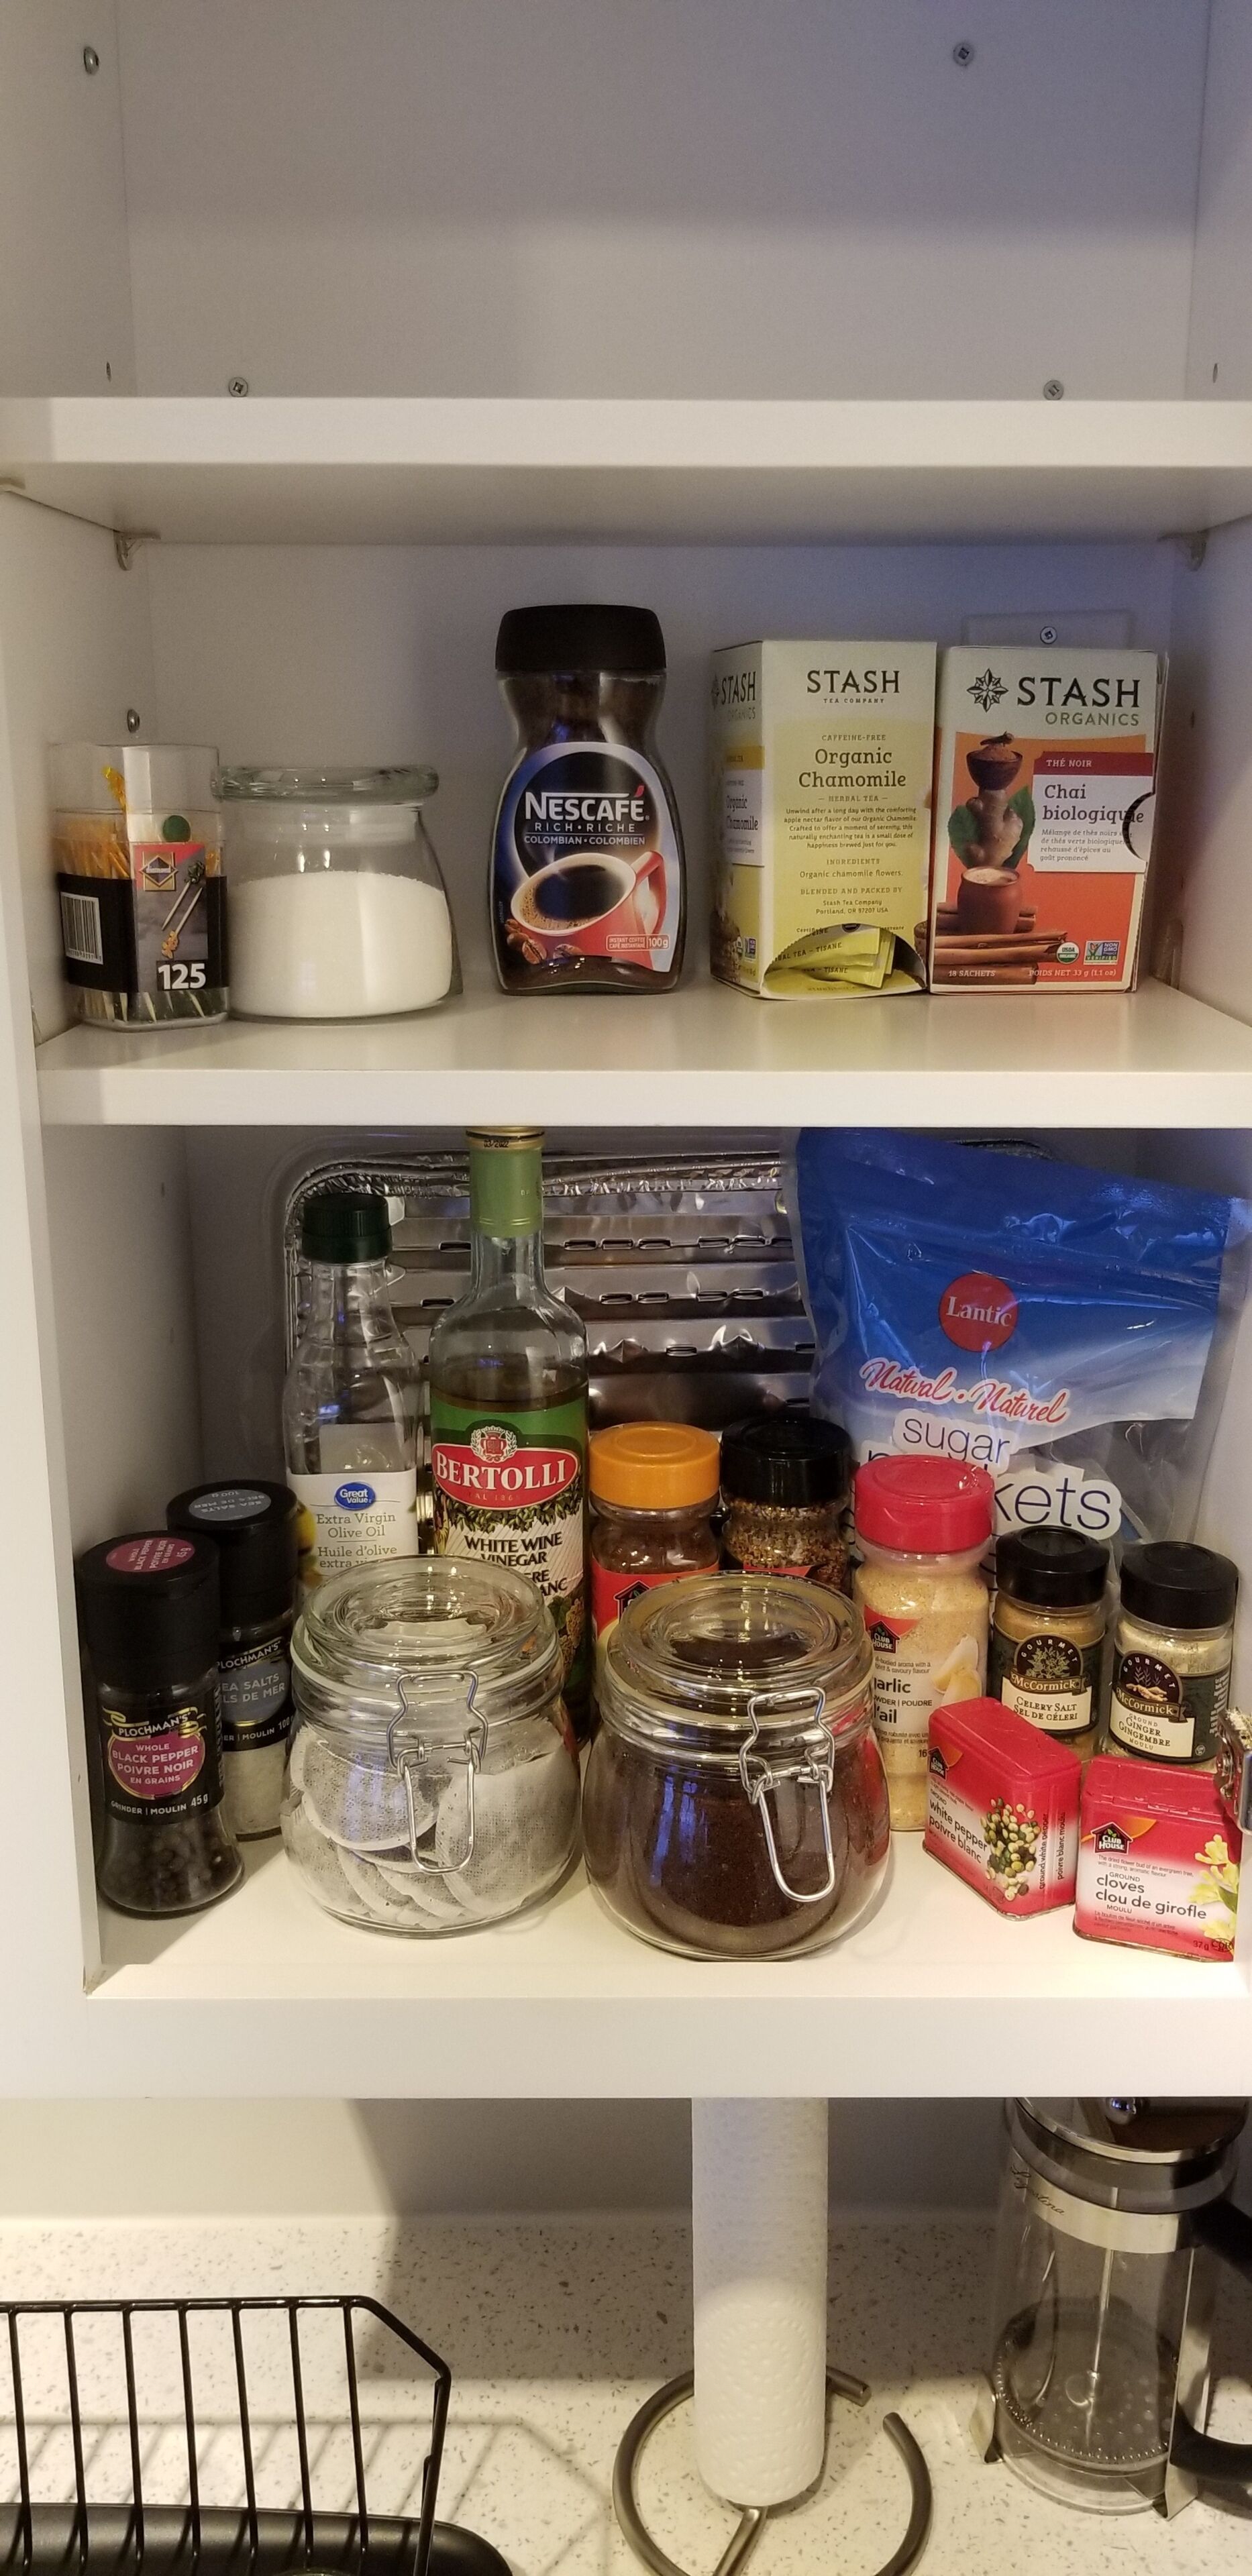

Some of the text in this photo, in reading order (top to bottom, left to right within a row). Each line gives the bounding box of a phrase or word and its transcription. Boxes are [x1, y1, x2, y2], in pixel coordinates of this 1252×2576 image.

[721, 671, 756, 704] STASH
[807, 669, 900, 694] STASH
[1017, 677, 1140, 727] STASH ORGANICS
[815, 747, 892, 768] Organic
[1046, 758, 1092, 767] THÉ NOIR
[798, 771, 906, 788] Chamomile
[1045, 784, 1086, 799] Chai
[525, 786, 645, 821] NESCAFÉ
[1043, 806, 1144, 824] biologique
[535, 822, 635, 832] RICH RICHE
[525, 836, 645, 845] COLOMBIAN COLOMBIEN
[800, 871, 829, 879] Organic
[816, 942, 842, 953] TISANE
[158, 963, 206, 991] 125
[946, 1295, 1012, 1327] Lantic
[861, 1360, 1067, 1424] Natural Naturel
[903, 1417, 1010, 1464] sugar
[436, 1451, 566, 1491] BERTOLLI
[340, 1488, 368, 1499] Great
[317, 1512, 396, 1525] Extra Virgin
[328, 1525, 385, 1538] Olive Oil
[318, 1545, 397, 1557] Huile d'olive
[464, 1532, 562, 1553] WHITE WINE
[319, 1558, 352, 1568] extra
[481, 1552, 547, 1566] VINEGAR
[874, 1632, 890, 1643] CLUB
[1021, 1639, 1078, 1662] GOURMET
[1123, 1656, 1176, 1688] GOURMET
[244, 1673, 279, 1690] SALTS
[1011, 1674, 1076, 1690] McCormick
[243, 1682, 285, 1702] DE MER
[1116, 1686, 1174, 1715] McCormick
[1016, 1696, 1078, 1712] CELERY SALT
[1014, 1705, 1078, 1721] SEL DE CÉLERI
[1129, 1713, 1158, 1727] GROUND
[119, 1713, 189, 1737] PLOCHMAN'S
[242, 1727, 275, 1740] MOULIN
[278, 1718, 290, 1730] 100
[1125, 1717, 1161, 1737] GINGER
[1118, 1721, 1171, 1747] GINGEMBRE
[136, 1743, 170, 1752] WHOLE
[1129, 1737, 1154, 1750] MOULU
[112, 1746, 199, 1763] BLACK PEPPER
[117, 1759, 194, 1775] POIVRE NOIR
[145, 1774, 180, 1784] GRAINS
[111, 1801, 187, 1815] GRINDER MOULIN
[929, 1799, 953, 1825] white
[955, 1820, 988, 1852] pepper
[929, 1815, 956, 1843] poivre
[957, 1834, 982, 1864] blanc
[1098, 1841, 1125, 1850] HOUSE
[1102, 1835, 1122, 1844] CLUB
[1039, 1840, 1047, 1862] white
[1056, 1835, 1065, 1880] poivre blanc
[1109, 1872, 1141, 1882] GROUND
[1129, 1867, 1149, 1875] aromatic
[1159, 1867, 1182, 1875] evergreen
[1096, 1874, 1145, 1894] cloves
[1096, 1888, 1207, 1919] clou de girofle
[1106, 1904, 1133, 1914] MOULU
